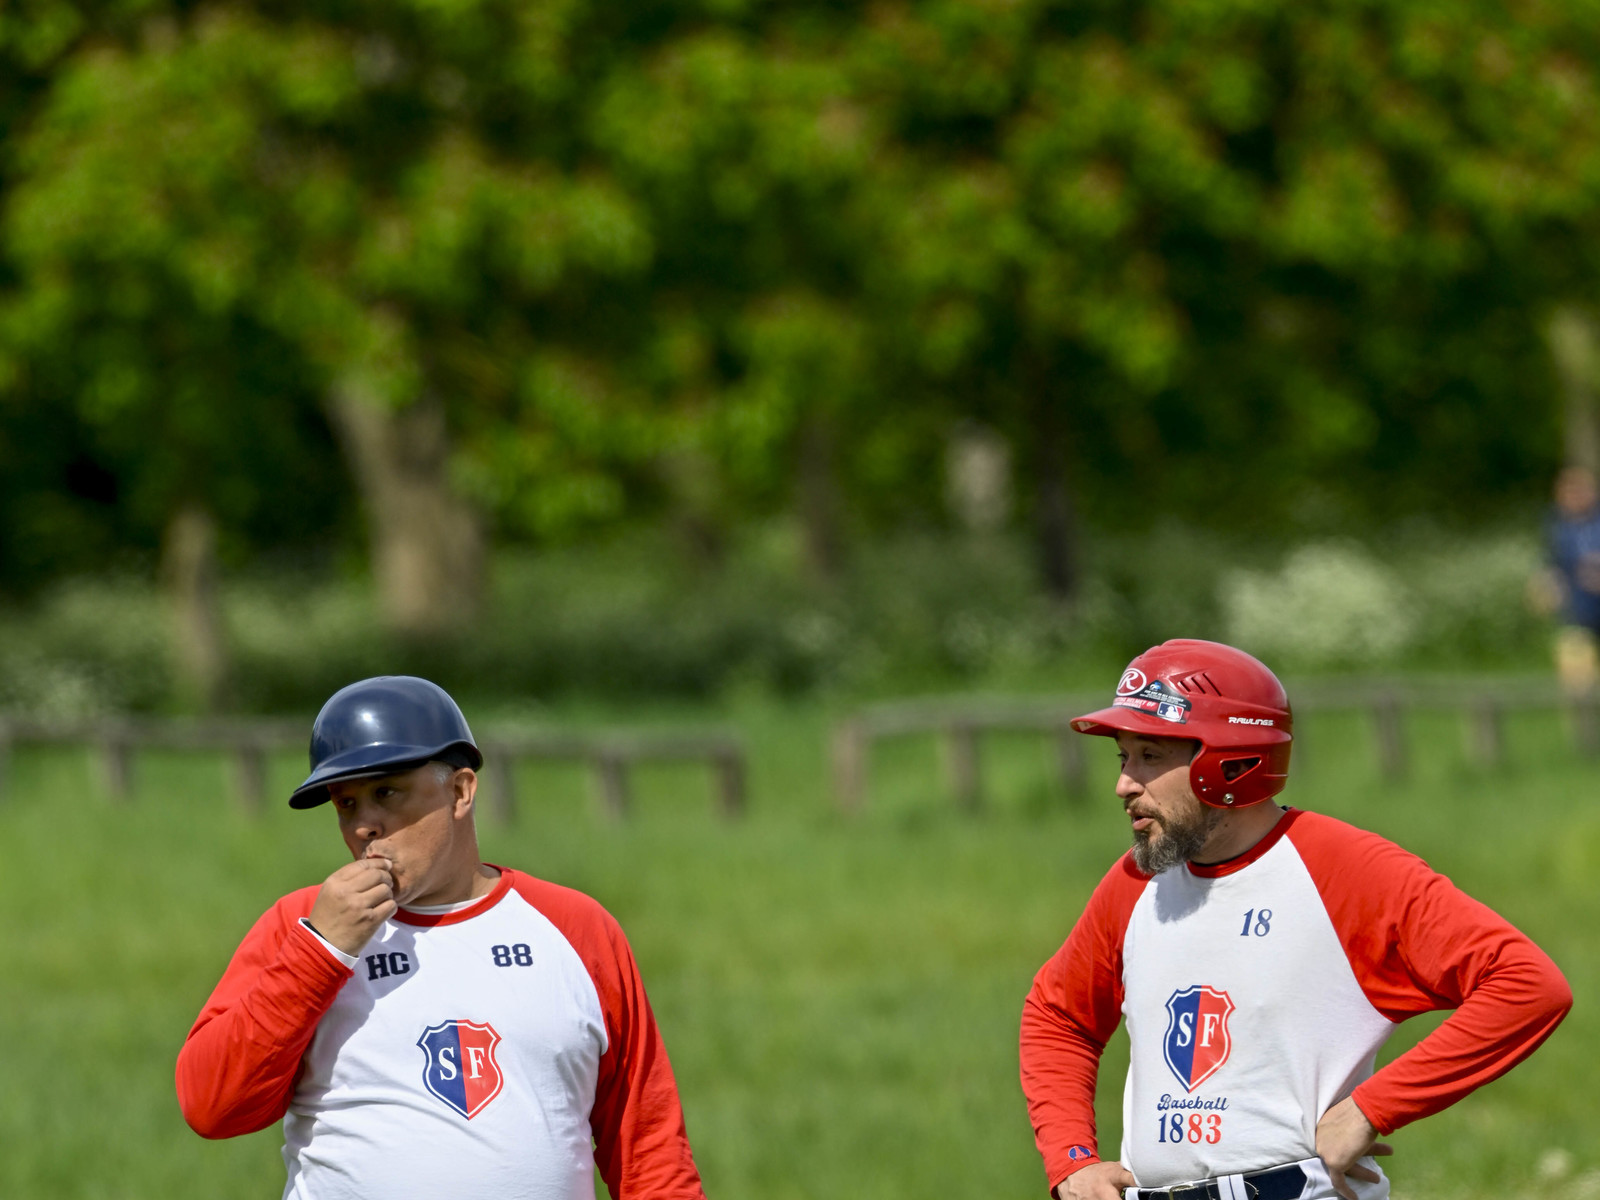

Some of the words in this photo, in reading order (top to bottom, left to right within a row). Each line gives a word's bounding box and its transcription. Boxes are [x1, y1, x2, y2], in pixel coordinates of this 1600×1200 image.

[1118, 670, 1139, 690] R
[1228, 716, 1274, 726] RAWLINGS
[1240, 908, 1272, 937] 18
[365, 952, 410, 981] HC
[491, 943, 533, 967] 88
[1157, 1093, 1230, 1111] Baseball
[1158, 1113, 1222, 1144] 1883
